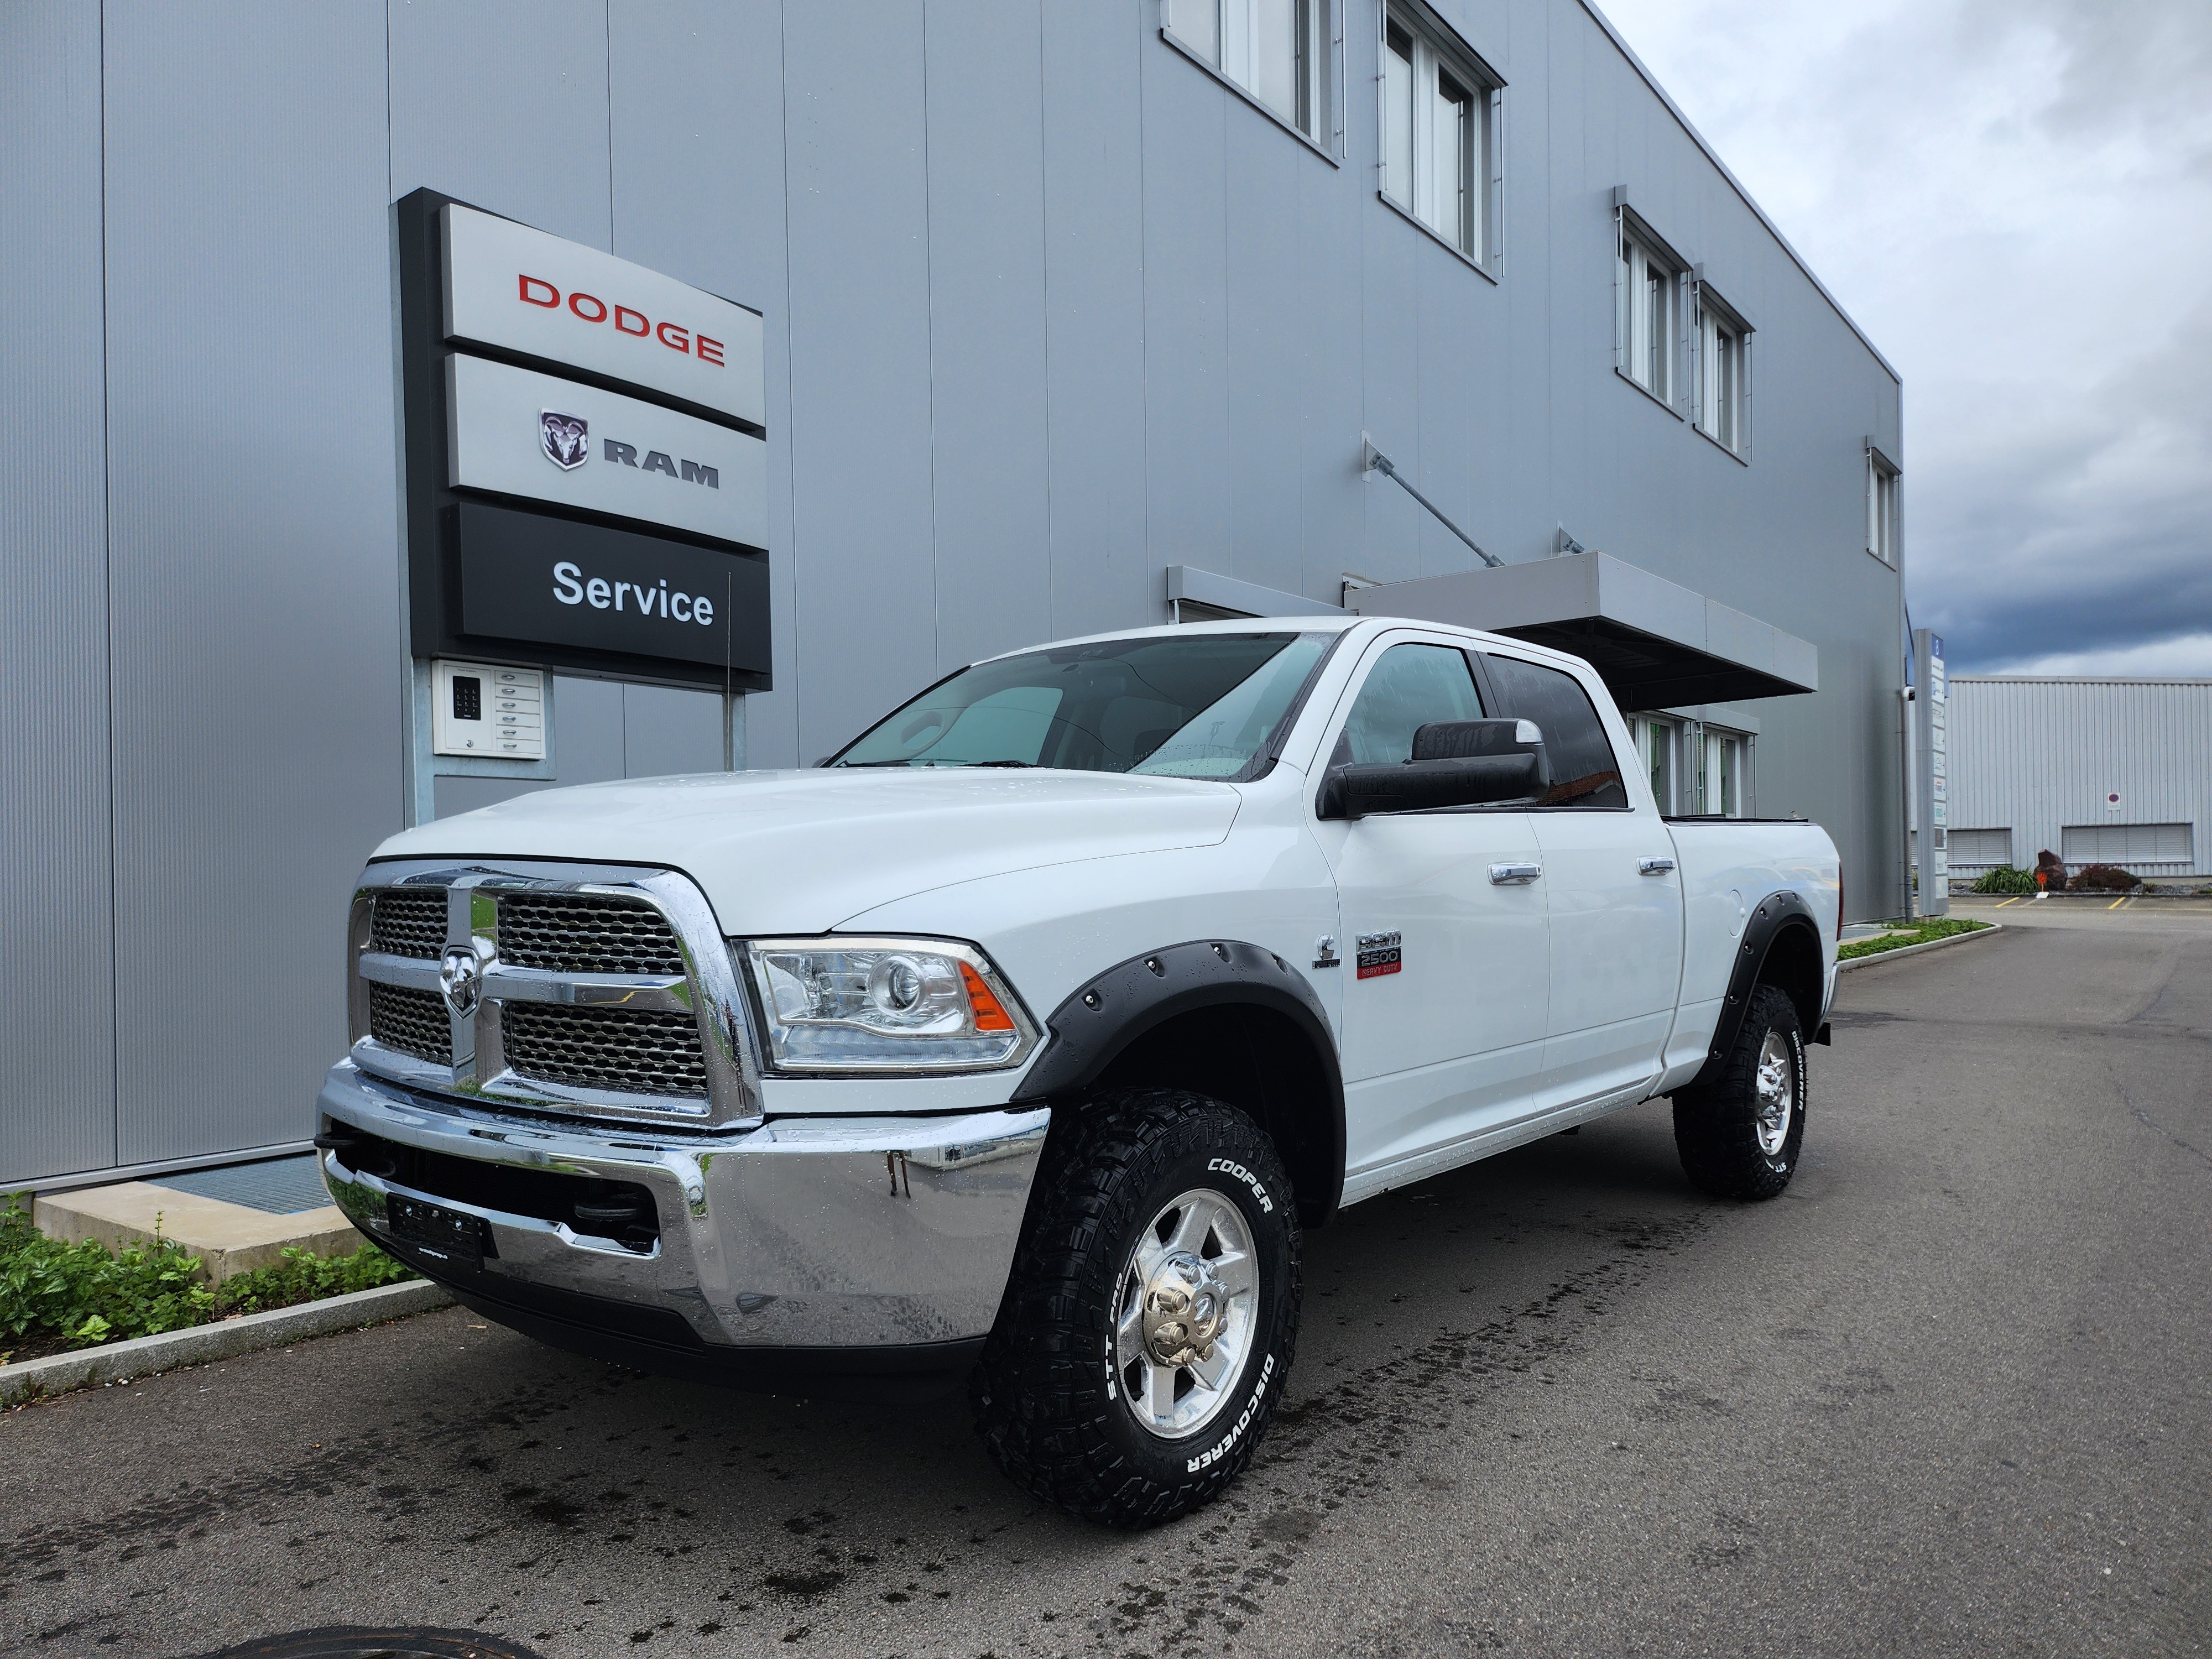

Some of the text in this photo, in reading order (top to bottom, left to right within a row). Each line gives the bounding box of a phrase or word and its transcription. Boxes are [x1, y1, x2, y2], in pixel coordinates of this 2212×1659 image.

[519, 274, 725, 367] DODGE
[604, 438, 719, 489] RAM
[553, 561, 714, 625] Service
[1361, 951, 1398, 966] 2500
[1362, 963, 1398, 977] HEAVY DUTY
[1792, 1031, 1804, 1110] DISCOVERER
[1208, 1159, 1273, 1213] COOPER
[1105, 1272, 1122, 1400] STT PRO
[1187, 1353, 1275, 1472] DISCOVERER
